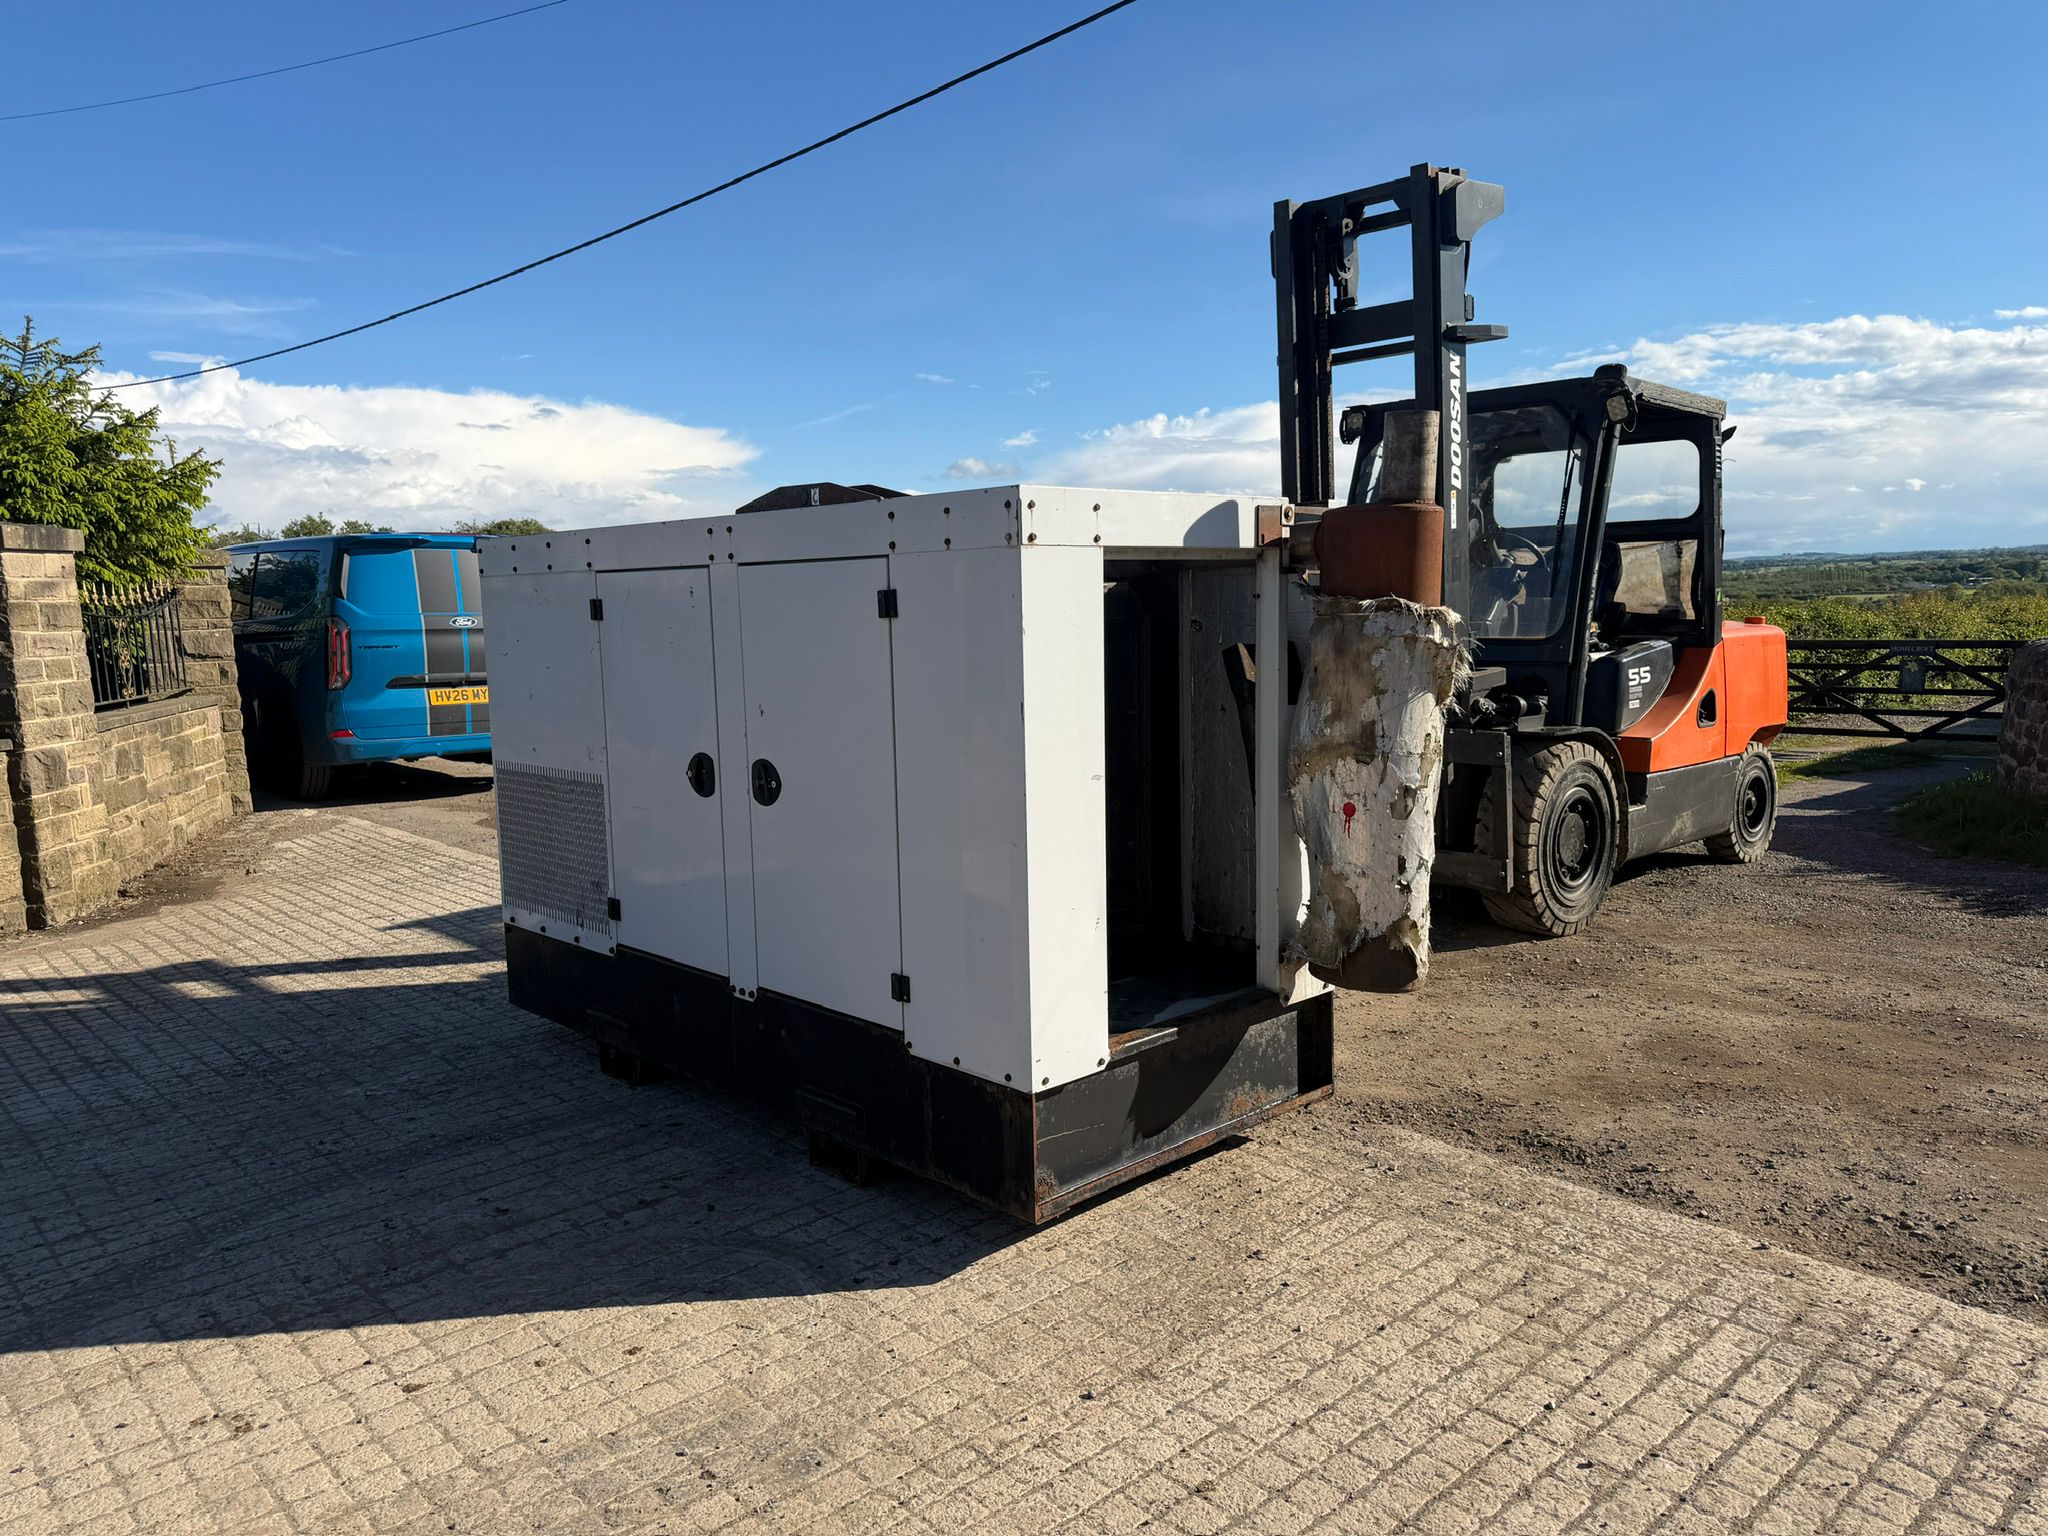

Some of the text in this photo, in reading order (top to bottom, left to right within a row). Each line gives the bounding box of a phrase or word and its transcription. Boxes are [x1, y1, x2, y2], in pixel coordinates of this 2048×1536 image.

[1450, 352, 1461, 489] DOOSAN
[1628, 666, 1651, 686] 55
[435, 690, 469, 702] HV26
